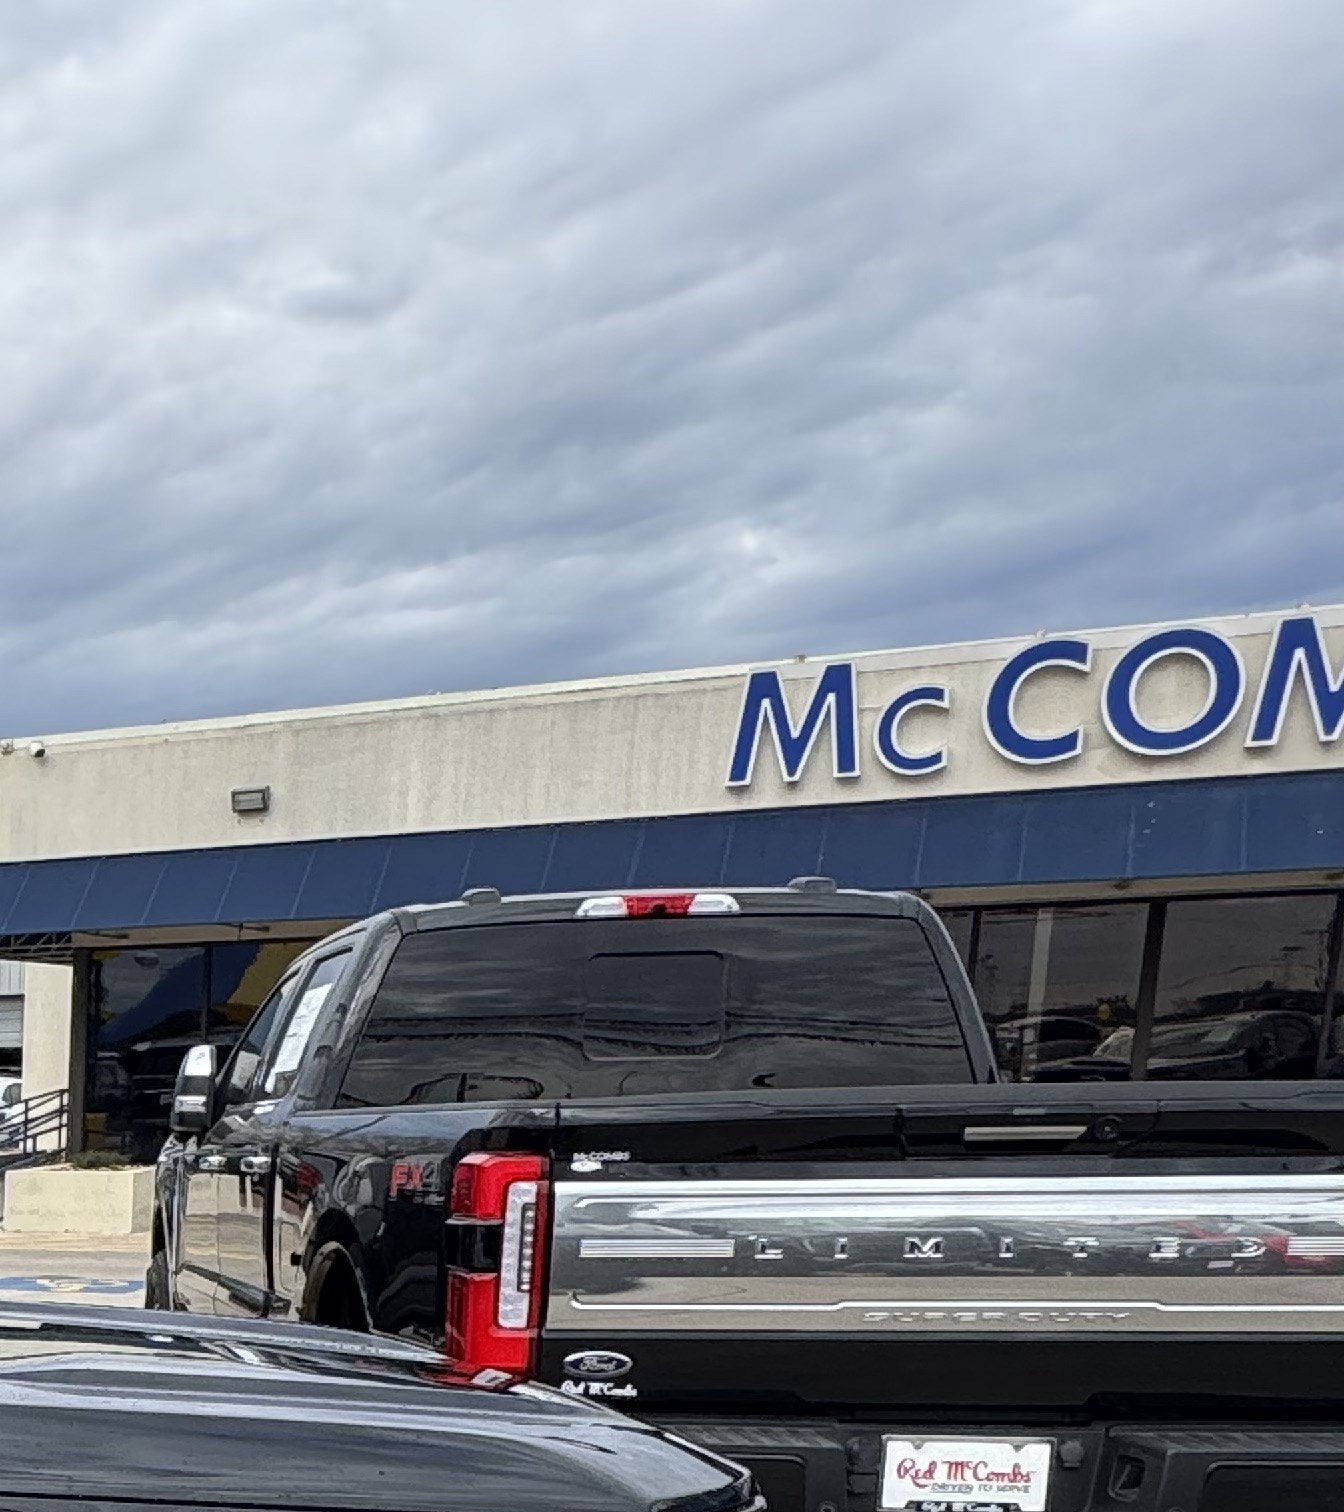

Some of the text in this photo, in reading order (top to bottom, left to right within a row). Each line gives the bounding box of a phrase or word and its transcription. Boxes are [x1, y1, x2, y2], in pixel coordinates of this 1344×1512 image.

[748, 1235, 1266, 1260] LIMITED
[863, 1310, 1132, 1324] SUPER DUTY
[896, 1457, 938, 1489] Red
[978, 1484, 993, 1494] TO
